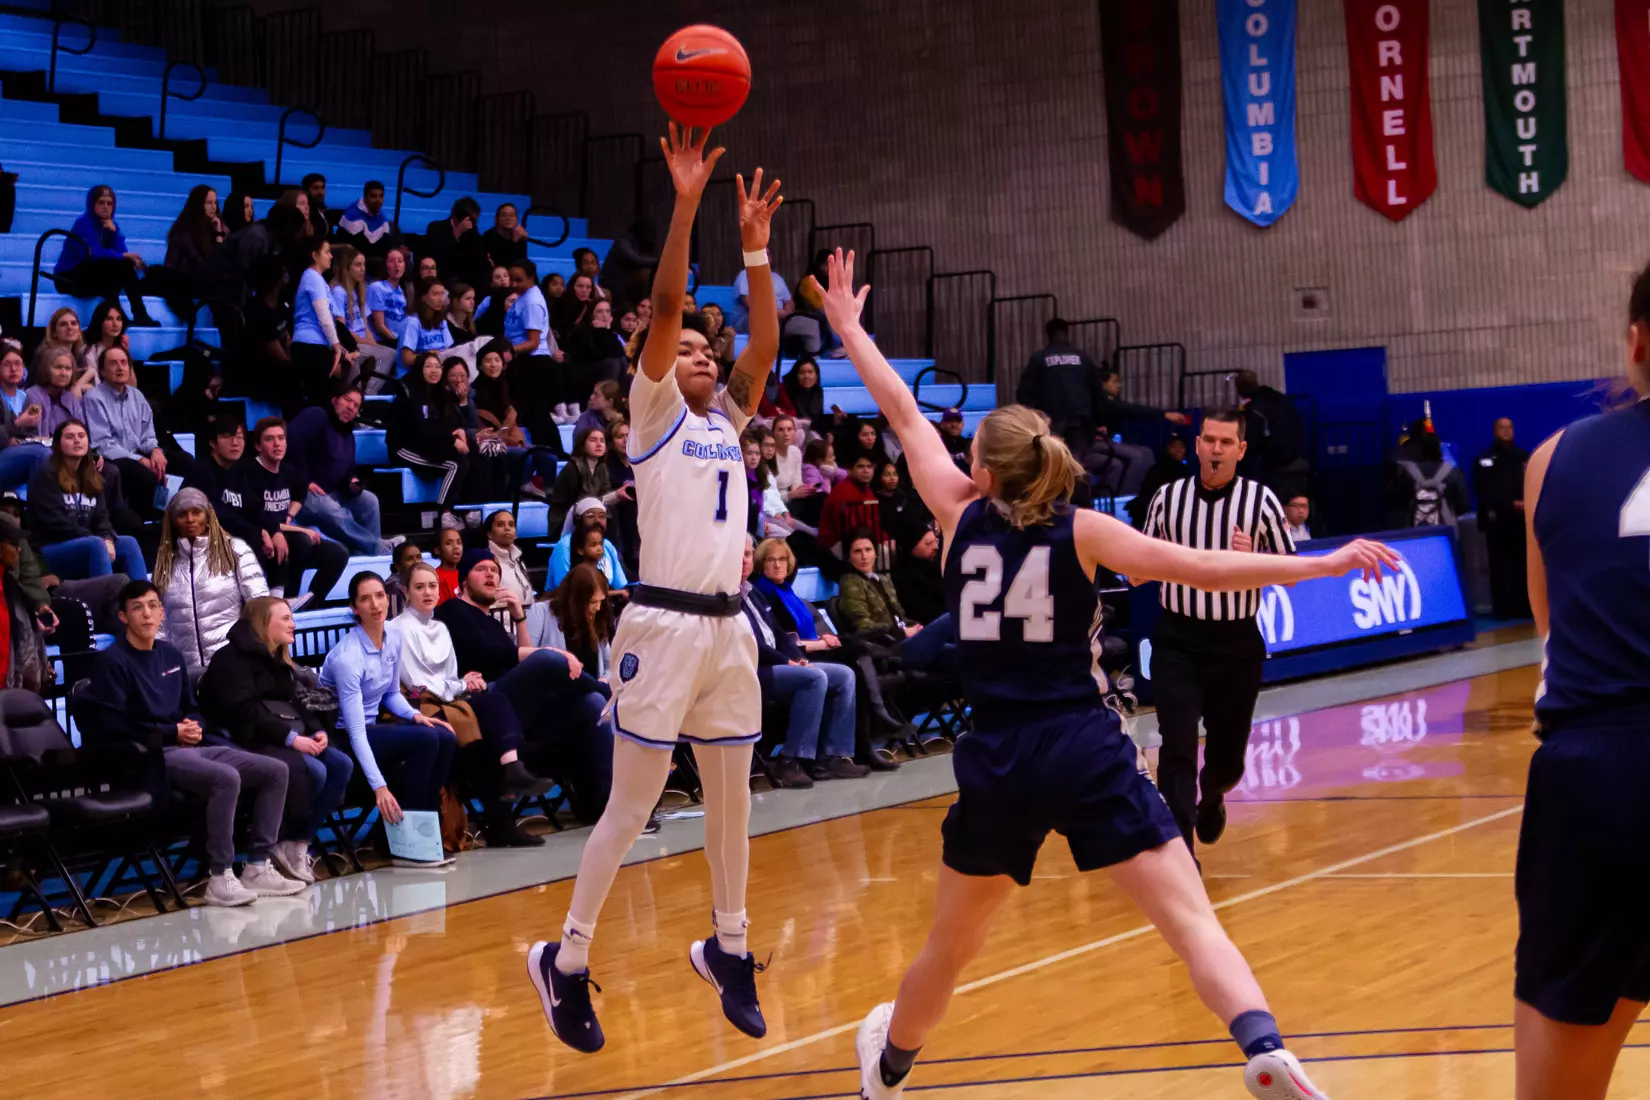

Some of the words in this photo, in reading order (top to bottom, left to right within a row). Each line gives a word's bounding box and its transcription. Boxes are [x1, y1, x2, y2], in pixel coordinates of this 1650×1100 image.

[1124, 0, 1164, 208] ROWN
[1245, 0, 1274, 216] OLUMBIA
[1510, 0, 1540, 195] RTMOUTH
[714, 469, 729, 522] 1
[960, 545, 1054, 642] 24
[1350, 571, 1407, 630] SNY
